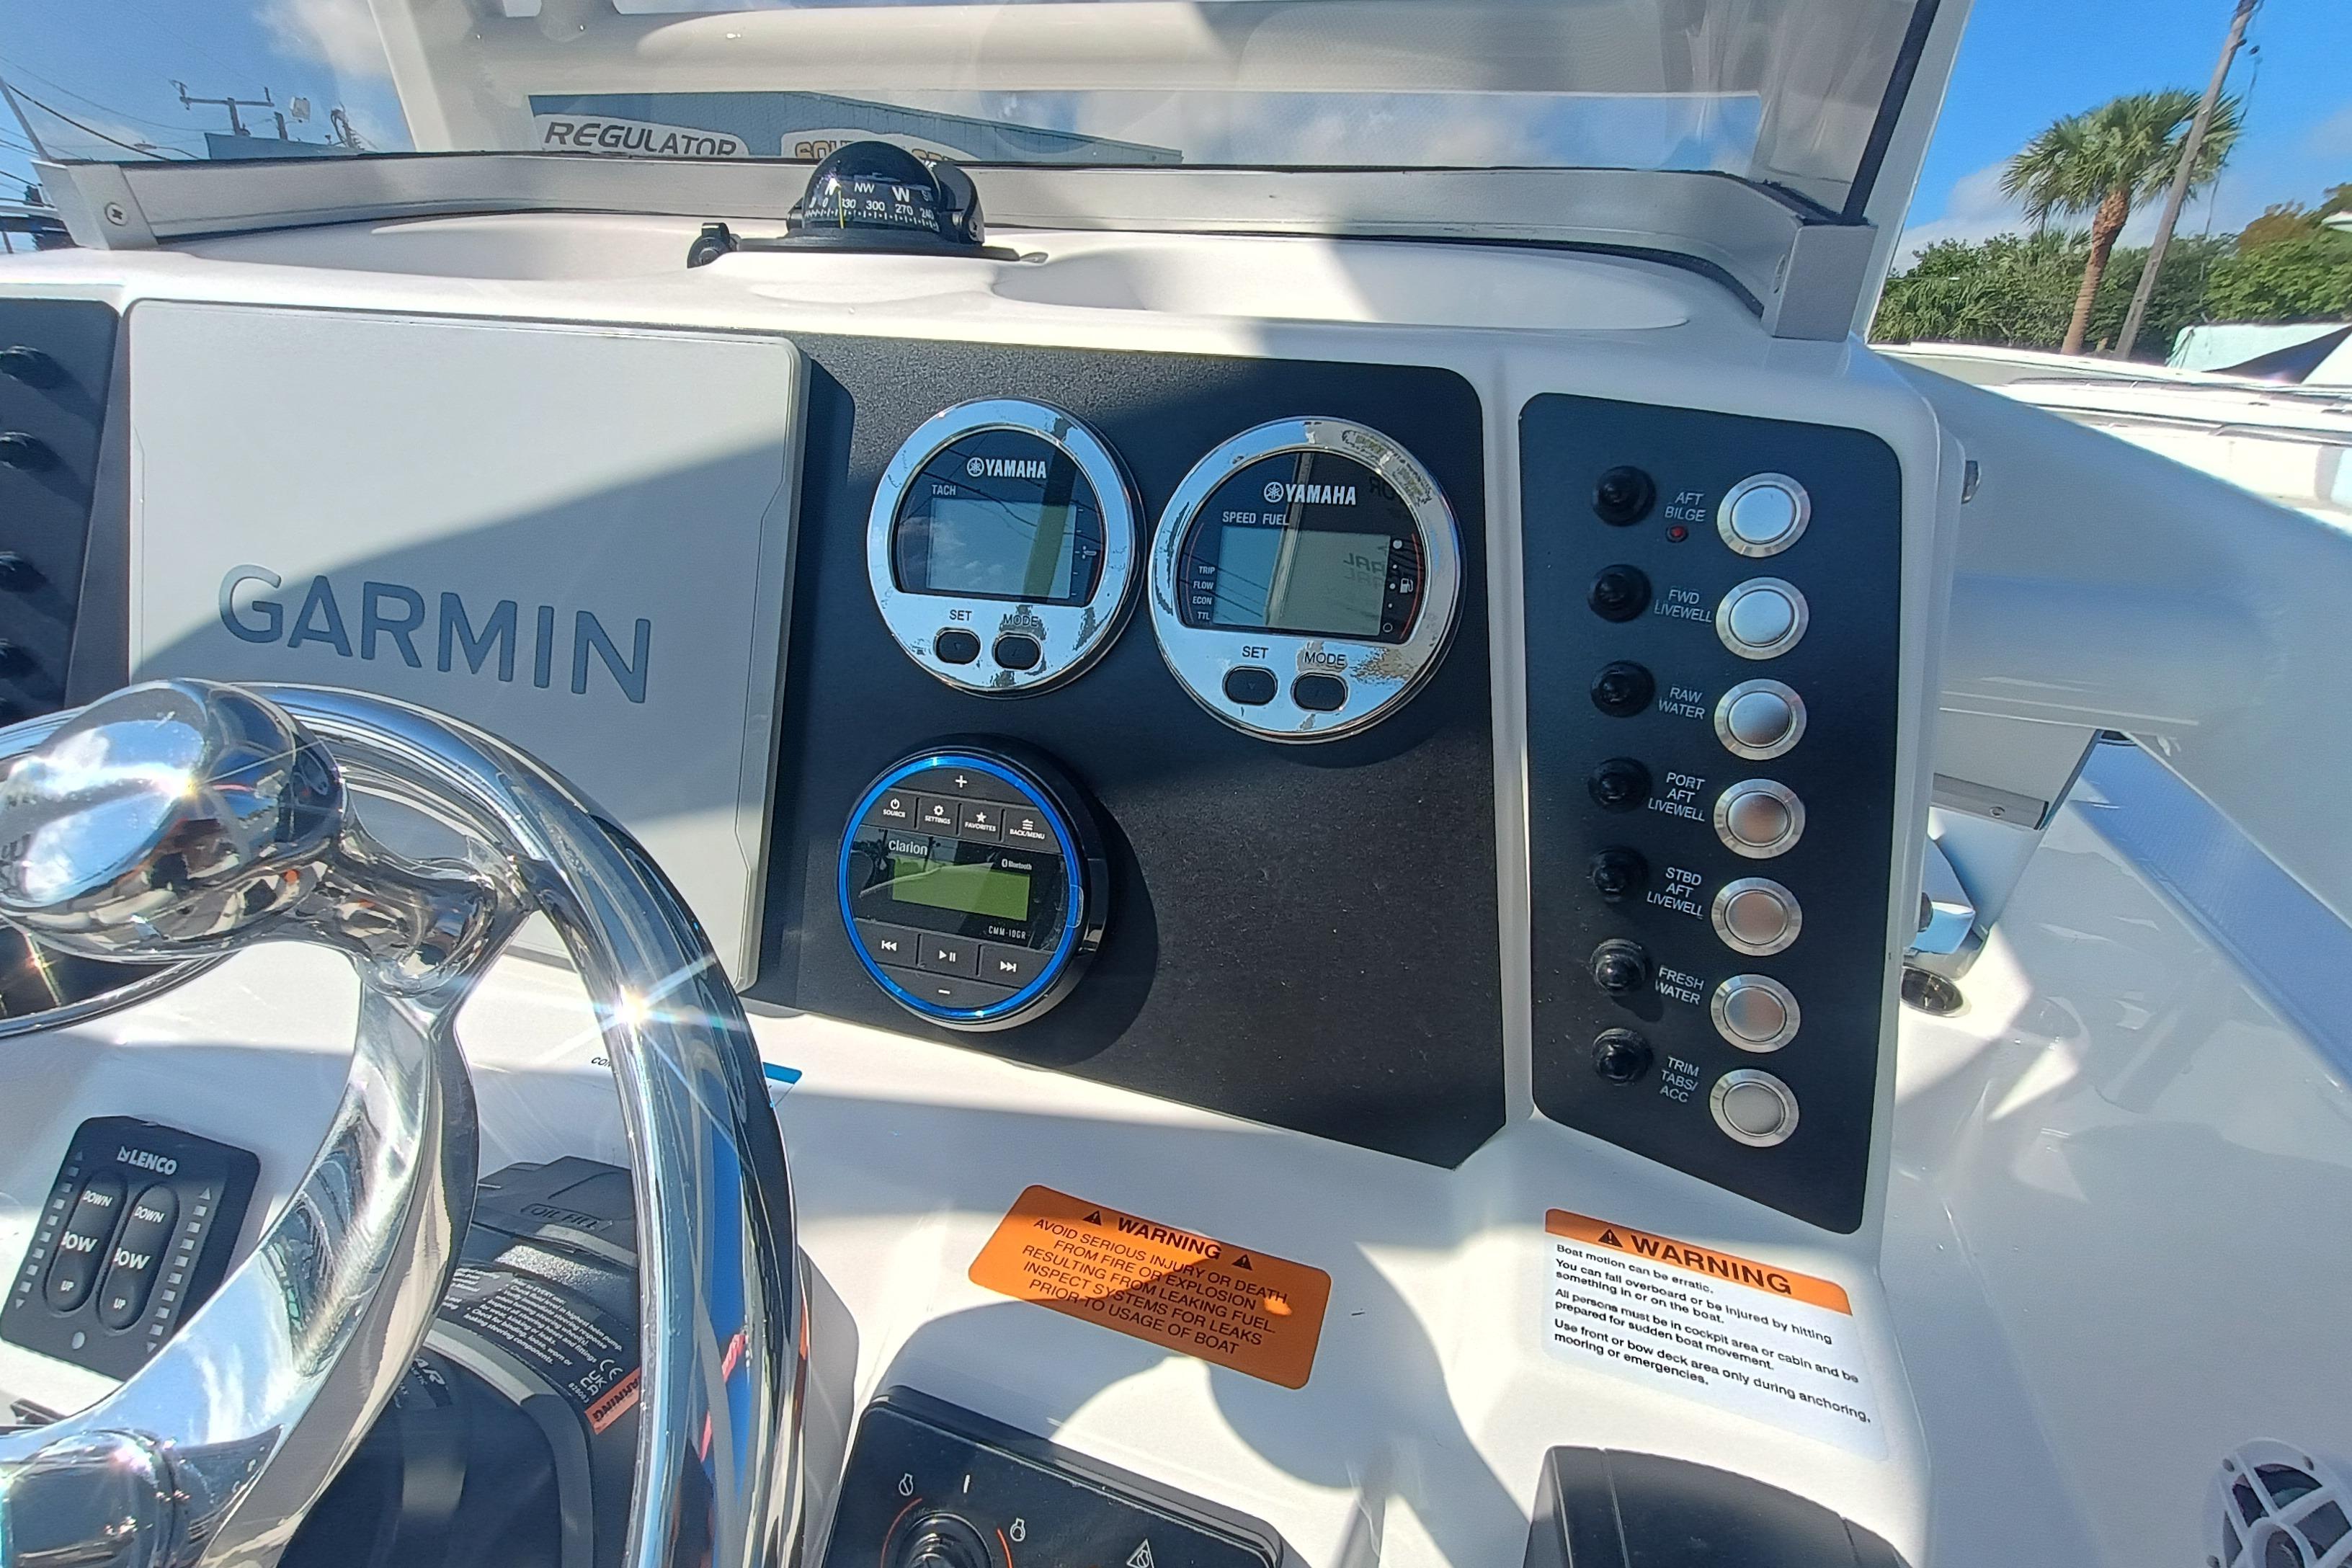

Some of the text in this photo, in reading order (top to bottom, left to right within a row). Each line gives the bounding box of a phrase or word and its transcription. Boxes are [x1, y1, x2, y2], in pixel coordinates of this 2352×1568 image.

[544, 122, 736, 156] REGULATOR
[855, 182, 875, 194] NW
[891, 186, 909, 202] W
[865, 200, 885, 211] 300
[895, 203, 913, 215] 270
[985, 459, 1046, 478] YAMAHA
[932, 484, 956, 496] TACH
[1286, 484, 1356, 506] YAMAHA
[1675, 492, 1704, 506] AFT
[1222, 512, 1290, 525] SPEED FUEL
[1665, 506, 1706, 522] BILGE
[1198, 566, 1216, 574] TRIP
[1193, 581, 1213, 589] FLOW
[1193, 596, 1212, 605] ECON
[1668, 589, 1699, 605] FWD
[949, 610, 972, 621] SET
[1003, 613, 1039, 627] MODE
[1654, 602, 1712, 623] LIVEWELL
[218, 564, 651, 704] GARMIN
[1242, 646, 1268, 659] SET
[1304, 651, 1346, 666] MODE
[1670, 687, 1702, 703] RAW
[1659, 700, 1706, 720] WATER
[1665, 772, 1705, 791] PORT
[1667, 788, 1696, 804] AFT
[925, 815, 951, 824] SETTINGS
[1648, 799, 1706, 822] LIVEWELL
[964, 821, 997, 832] FAVORITES
[1010, 829, 1046, 839] BACK/MENU
[888, 839, 928, 855] Clarion
[1009, 860, 1032, 870] Bluetooth
[1665, 867, 1701, 886] STBD
[1665, 883, 1693, 898] AFT
[1647, 893, 1703, 918] LIVEWELL
[989, 925, 1026, 940] CMM-10GR
[1658, 966, 1705, 992] FRESH
[1655, 981, 1701, 1005] WATER
[1667, 1056, 1699, 1077] TRIM
[1660, 1069, 1698, 1092] TABS/
[1660, 1085, 1688, 1104] ACC
[128, 1149, 177, 1175] LENCO
[83, 1190, 112, 1207] DOWN
[134, 1206, 165, 1223] DOWN
[531, 1208, 560, 1218] OIL
[1118, 1217, 1221, 1260] WARNING
[1034, 1219, 1287, 1303] AVOID SERIOUS INJURY OR DEATH
[1557, 1244, 1713, 1293] Boat motion can be erratic.
[1631, 1235, 1791, 1295] WARNING
[1054, 1240, 1256, 1310] FROM FIRE OR EXPLOSION
[61, 1281, 74, 1291] UP
[1023, 1245, 1275, 1333] RESULTING FROM LEAKING FUEL.
[114, 1298, 126, 1309] UP
[1024, 1262, 1262, 1345] INSPECT SYSTEMS FOR LEAKS
[1556, 1272, 1616, 1294] something
[1621, 1288, 1631, 1297] in
[1651, 1298, 1666, 1306] on
[1670, 1302, 1688, 1313] the
[1693, 1308, 1724, 1323] boat.
[1556, 1259, 1577, 1270] You
[1581, 1268, 1601, 1278] can
[1605, 1273, 1621, 1283] fall
[1626, 1280, 1686, 1301] overboard
[1707, 1300, 1721, 1311] be
[1726, 1306, 1768, 1324] injured
[1773, 1319, 1787, 1332] by
[1791, 1324, 1832, 1345] hitting
[566, 1311, 589, 1327] highest
[1030, 1279, 1239, 1354] PRIOR TO USAGE OF BOAT
[579, 1329, 607, 1348] response
[1556, 1301, 1773, 1369] prepared for sudden boat movement.
[1556, 1289, 1569, 1298] All
[1573, 1295, 1618, 1312] persons
[1621, 1309, 1649, 1322] must
[1653, 1316, 1667, 1326] be
[1671, 1322, 1681, 1330] in
[1685, 1327, 1728, 1344] cockpit
[1732, 1340, 1758, 1353] area
[1778, 1354, 1812, 1369] cabin
[1815, 1365, 1839, 1377] and
[1843, 1371, 1858, 1383] be
[548, 1348, 564, 1360] worn
[563, 1338, 576, 1347] and
[575, 1345, 597, 1362] fittings
[1555, 1334, 1603, 1355] mooring
[1624, 1355, 1708, 1384] emergencies.
[600, 1359, 623, 1381] CE
[1555, 1319, 1577, 1332] Use
[1582, 1327, 1608, 1342] front
[1628, 1340, 1653, 1355] bow
[1657, 1350, 1688, 1366] deck
[1691, 1360, 1719, 1374] area
[1723, 1371, 1749, 1384] only
[1754, 1378, 1795, 1399] during
[1799, 1393, 1870, 1422] anchoring,
[592, 1378, 639, 1422] ARNING
